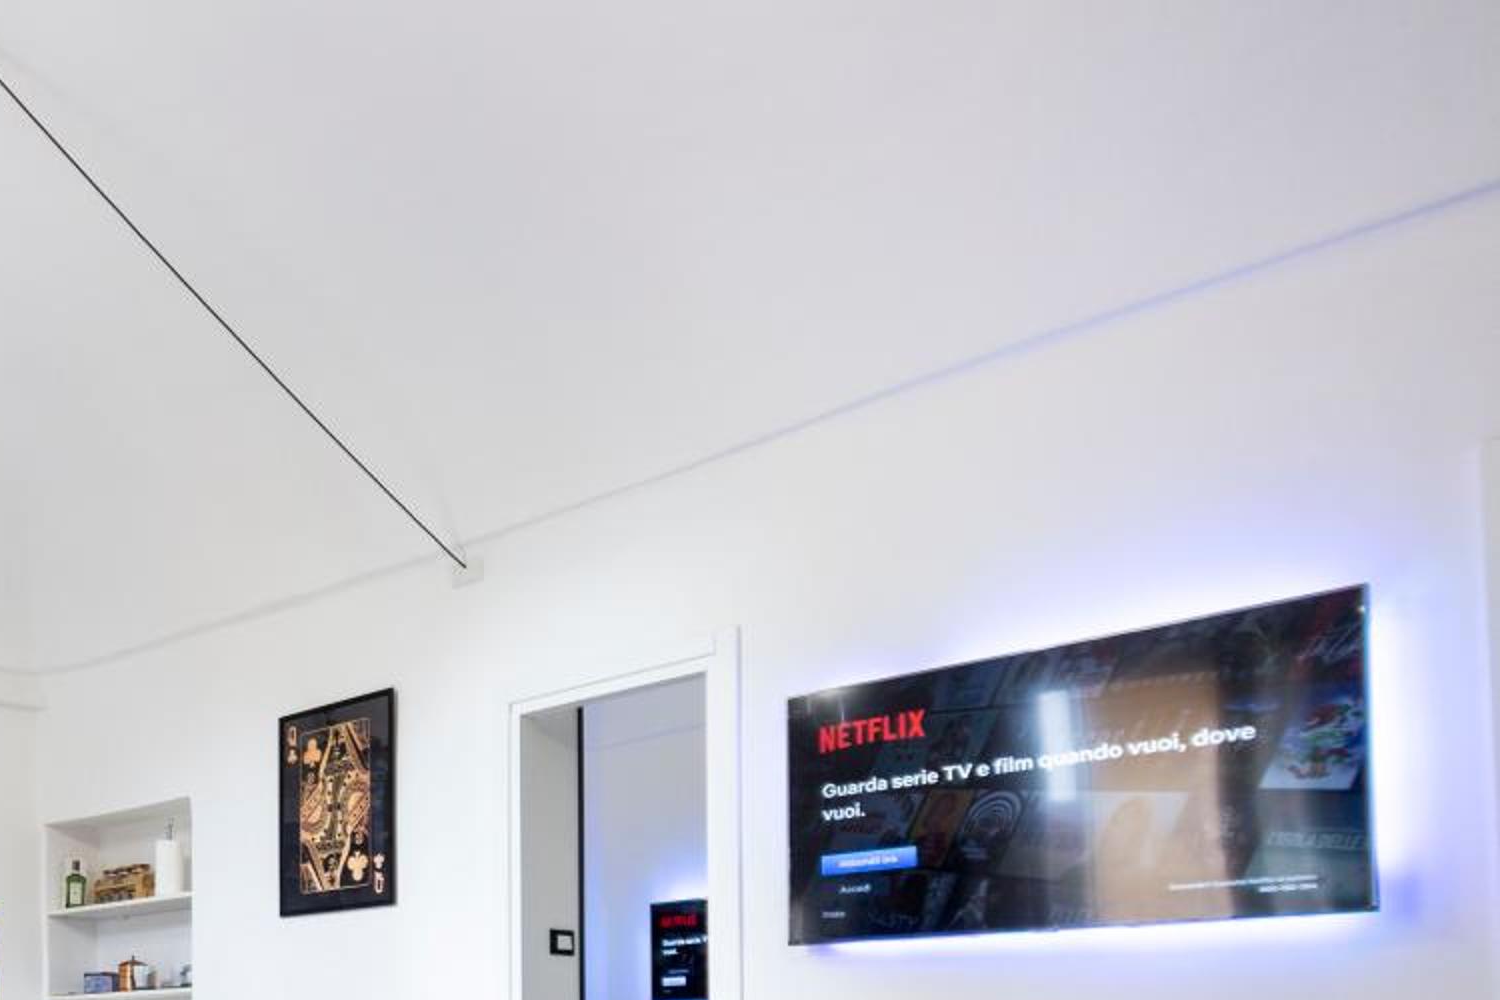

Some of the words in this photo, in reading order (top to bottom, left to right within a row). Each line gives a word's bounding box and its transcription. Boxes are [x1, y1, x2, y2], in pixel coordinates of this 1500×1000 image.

[818, 708, 925, 753] NETFLIX
[821, 775, 888, 799] Guarda
[891, 768, 939, 789] serie
[942, 763, 973, 782] TV
[975, 763, 990, 777] e
[993, 754, 1034, 776] film
[1037, 741, 1124, 772] quando
[1126, 731, 1187, 755] vuoi,
[1191, 724, 1258, 748] dove
[821, 802, 867, 822] vuoi.
